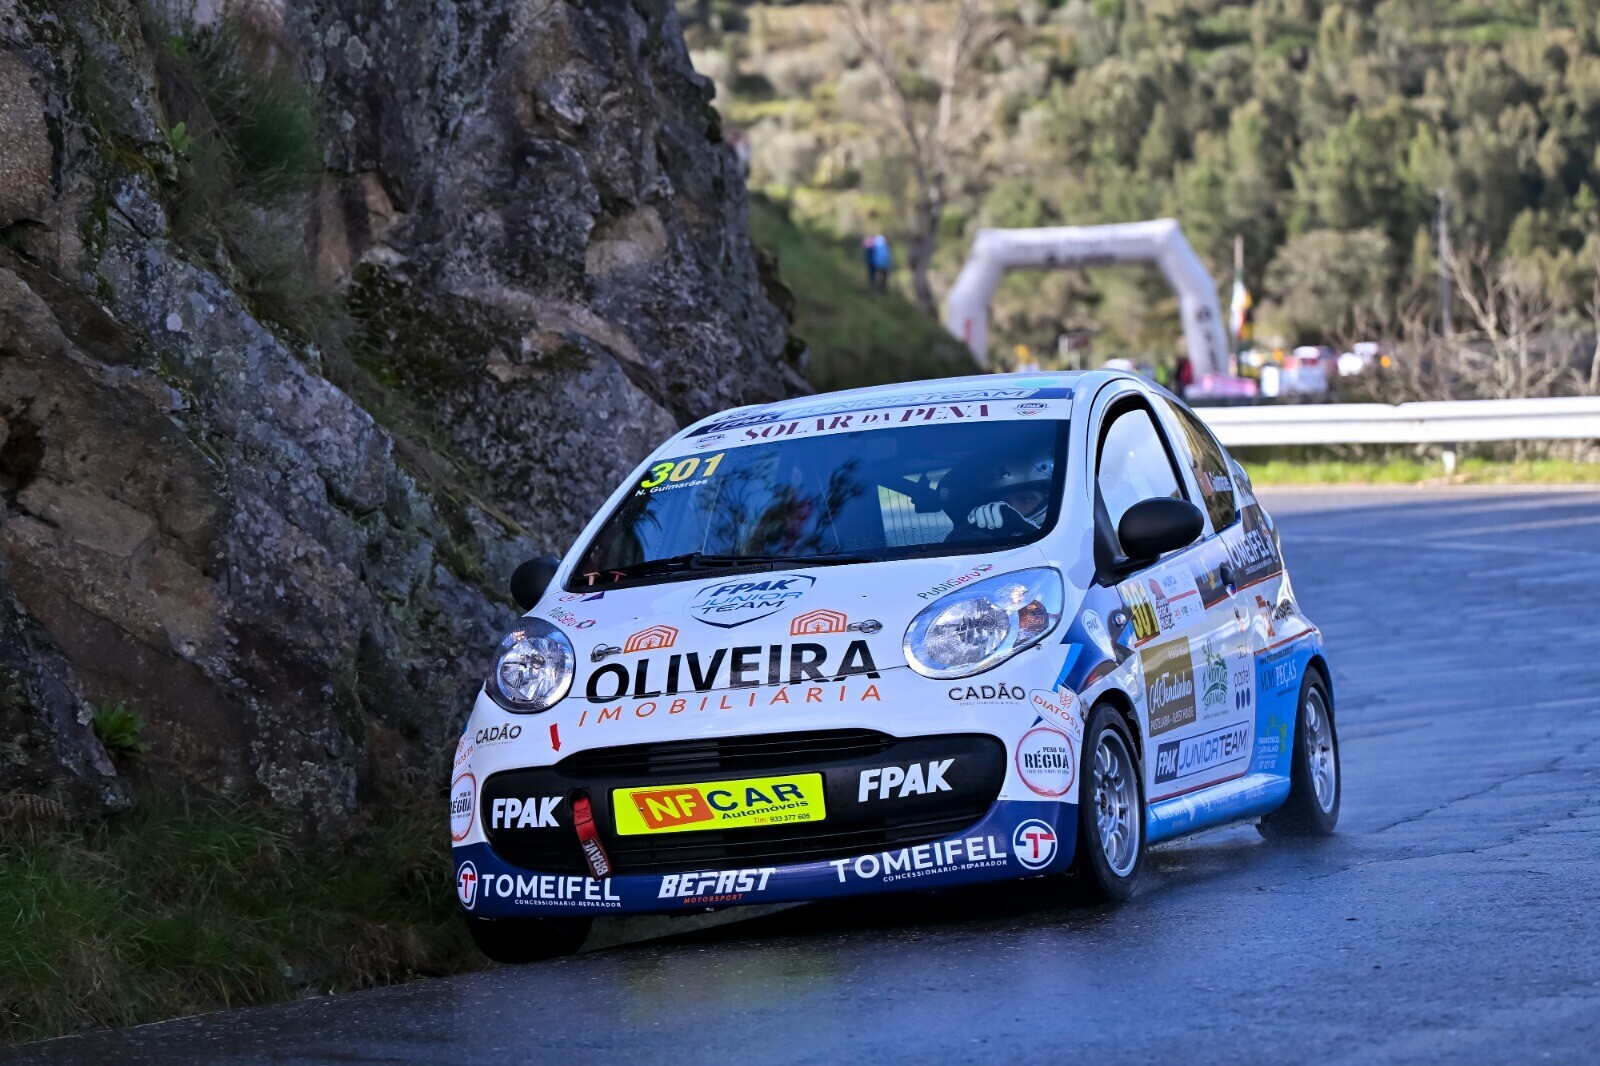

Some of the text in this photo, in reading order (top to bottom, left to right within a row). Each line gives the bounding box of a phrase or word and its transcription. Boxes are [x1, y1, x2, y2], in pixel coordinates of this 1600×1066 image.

[741, 415, 854, 441] SOLAR
[859, 411, 890, 426] DA
[900, 404, 989, 422] PENA
[641, 453, 726, 488] 301
[650, 479, 708, 494] Guimarães
[691, 591, 804, 608] JUNIOR
[710, 579, 800, 597] FPAK
[702, 600, 786, 614] TEAM
[1121, 579, 1159, 639] 301
[586, 640, 881, 704] OLIVEIRA
[1275, 659, 1297, 687] PEÇAS
[948, 682, 1026, 701] CADÃO
[578, 684, 881, 727] IMOBILIÁRIA
[476, 722, 522, 744] CADÃO
[1024, 750, 1069, 769] RÉGUA
[1157, 749, 1178, 776] FPAK
[858, 759, 955, 802] FPAK
[493, 797, 564, 829] FPAK
[645, 783, 804, 822] NF CAR
[721, 800, 809, 819] Automóveis
[830, 835, 1007, 883] TOMEIFEL
[482, 873, 620, 900] TOMEIFEL
[657, 868, 776, 898] BEFAST
[683, 894, 744, 903] MOTORSPORT
